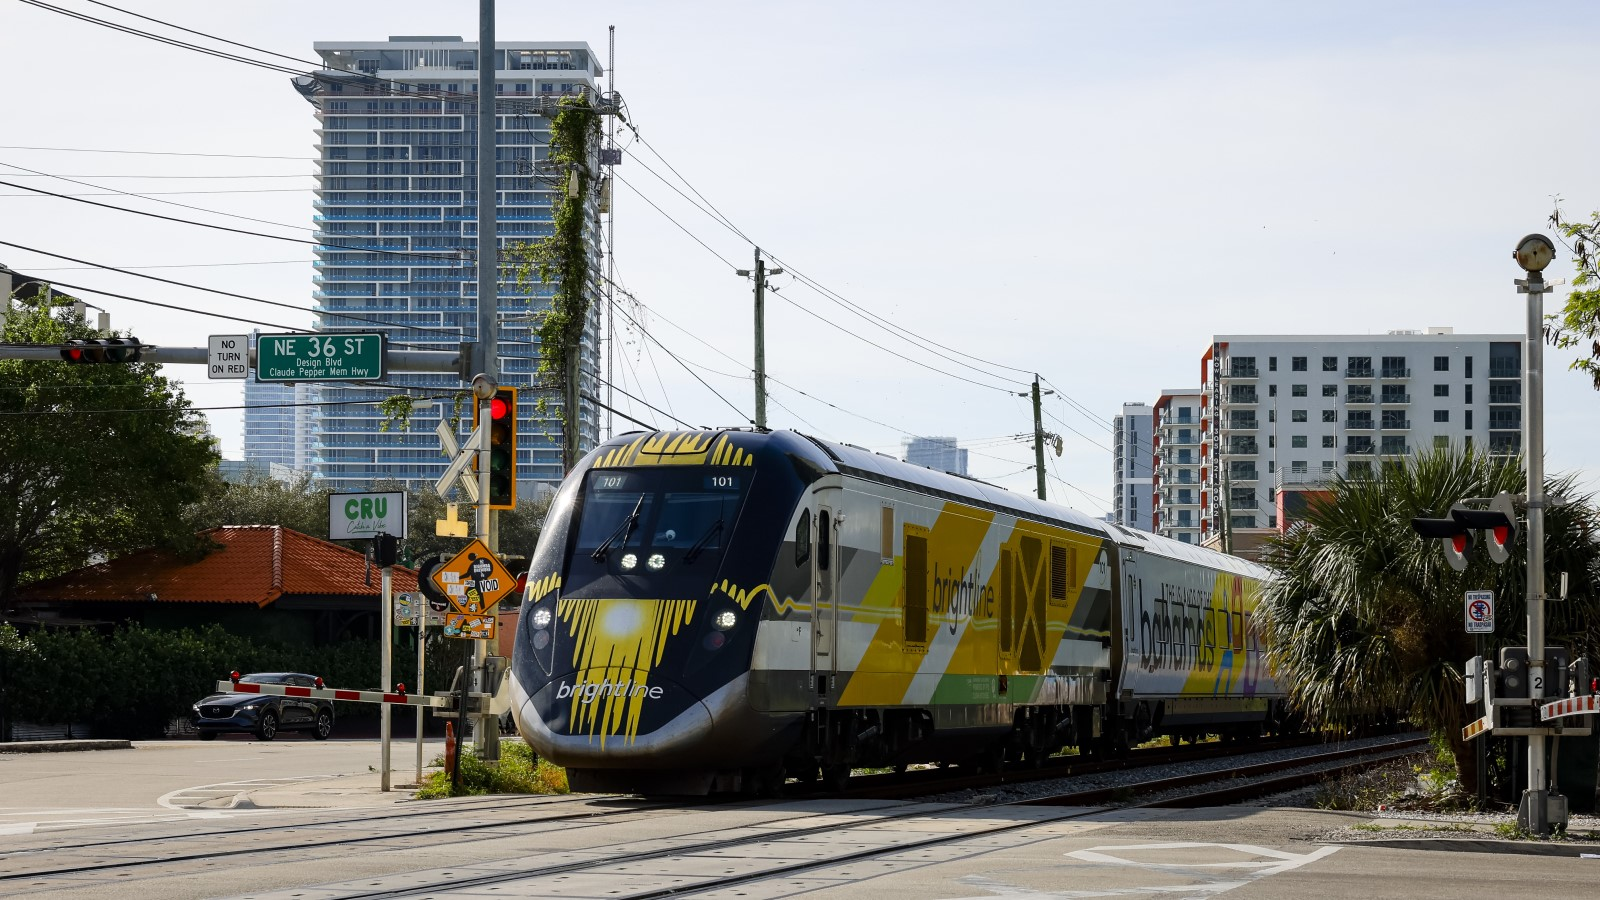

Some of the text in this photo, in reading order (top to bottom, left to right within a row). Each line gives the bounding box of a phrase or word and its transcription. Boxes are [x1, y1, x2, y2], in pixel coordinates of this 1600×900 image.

[221, 340, 235, 349] NO
[274, 337, 365, 358] NE 36 ST
[217, 353, 241, 361] TURN
[211, 365, 245, 374] ON RED
[296, 358, 342, 369] Design Blvd
[269, 366, 369, 379] Claude Pepper Mem Hwy
[603, 476, 622, 488] 101
[711, 476, 733, 487] 101
[345, 497, 387, 520] CRU
[480, 579, 499, 592] VOID
[932, 561, 995, 636] brightline
[1138, 578, 1215, 673] bahamas
[1534, 677, 1543, 689] 2
[556, 679, 664, 704] brightline
